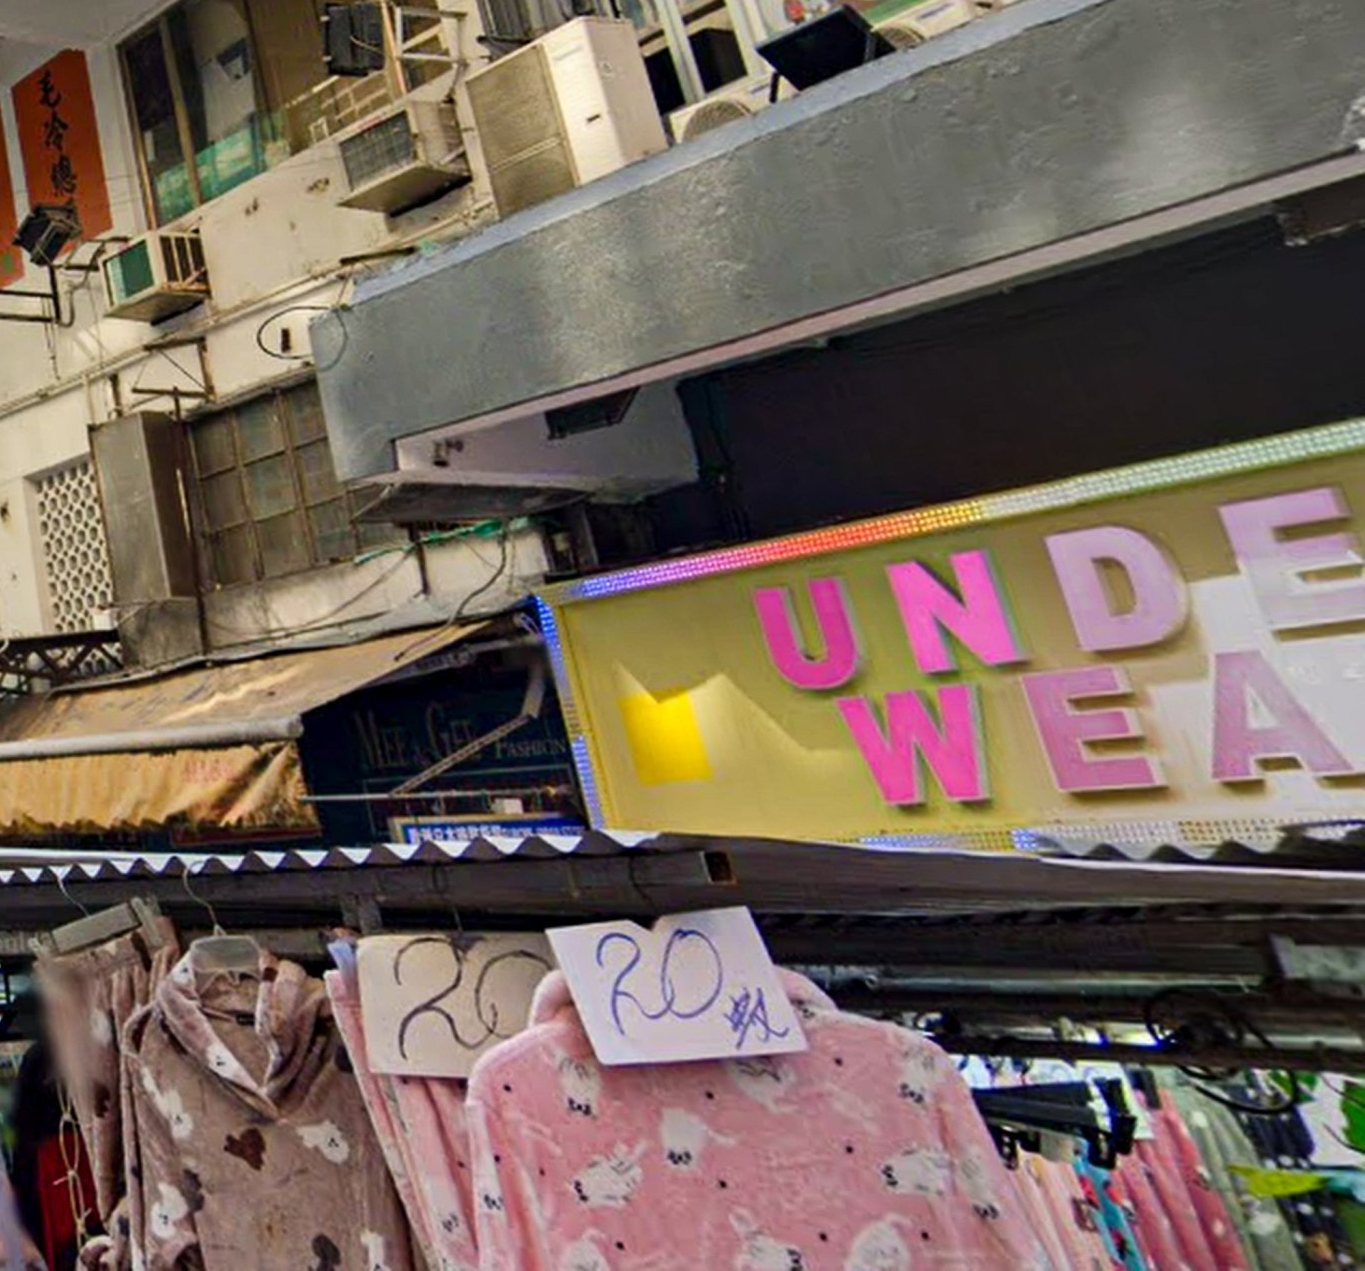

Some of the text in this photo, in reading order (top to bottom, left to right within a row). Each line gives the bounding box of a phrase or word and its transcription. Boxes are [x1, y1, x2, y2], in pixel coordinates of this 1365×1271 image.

[37, 69, 78, 201] 毛冷總
[594, 928, 725, 1035] 20
